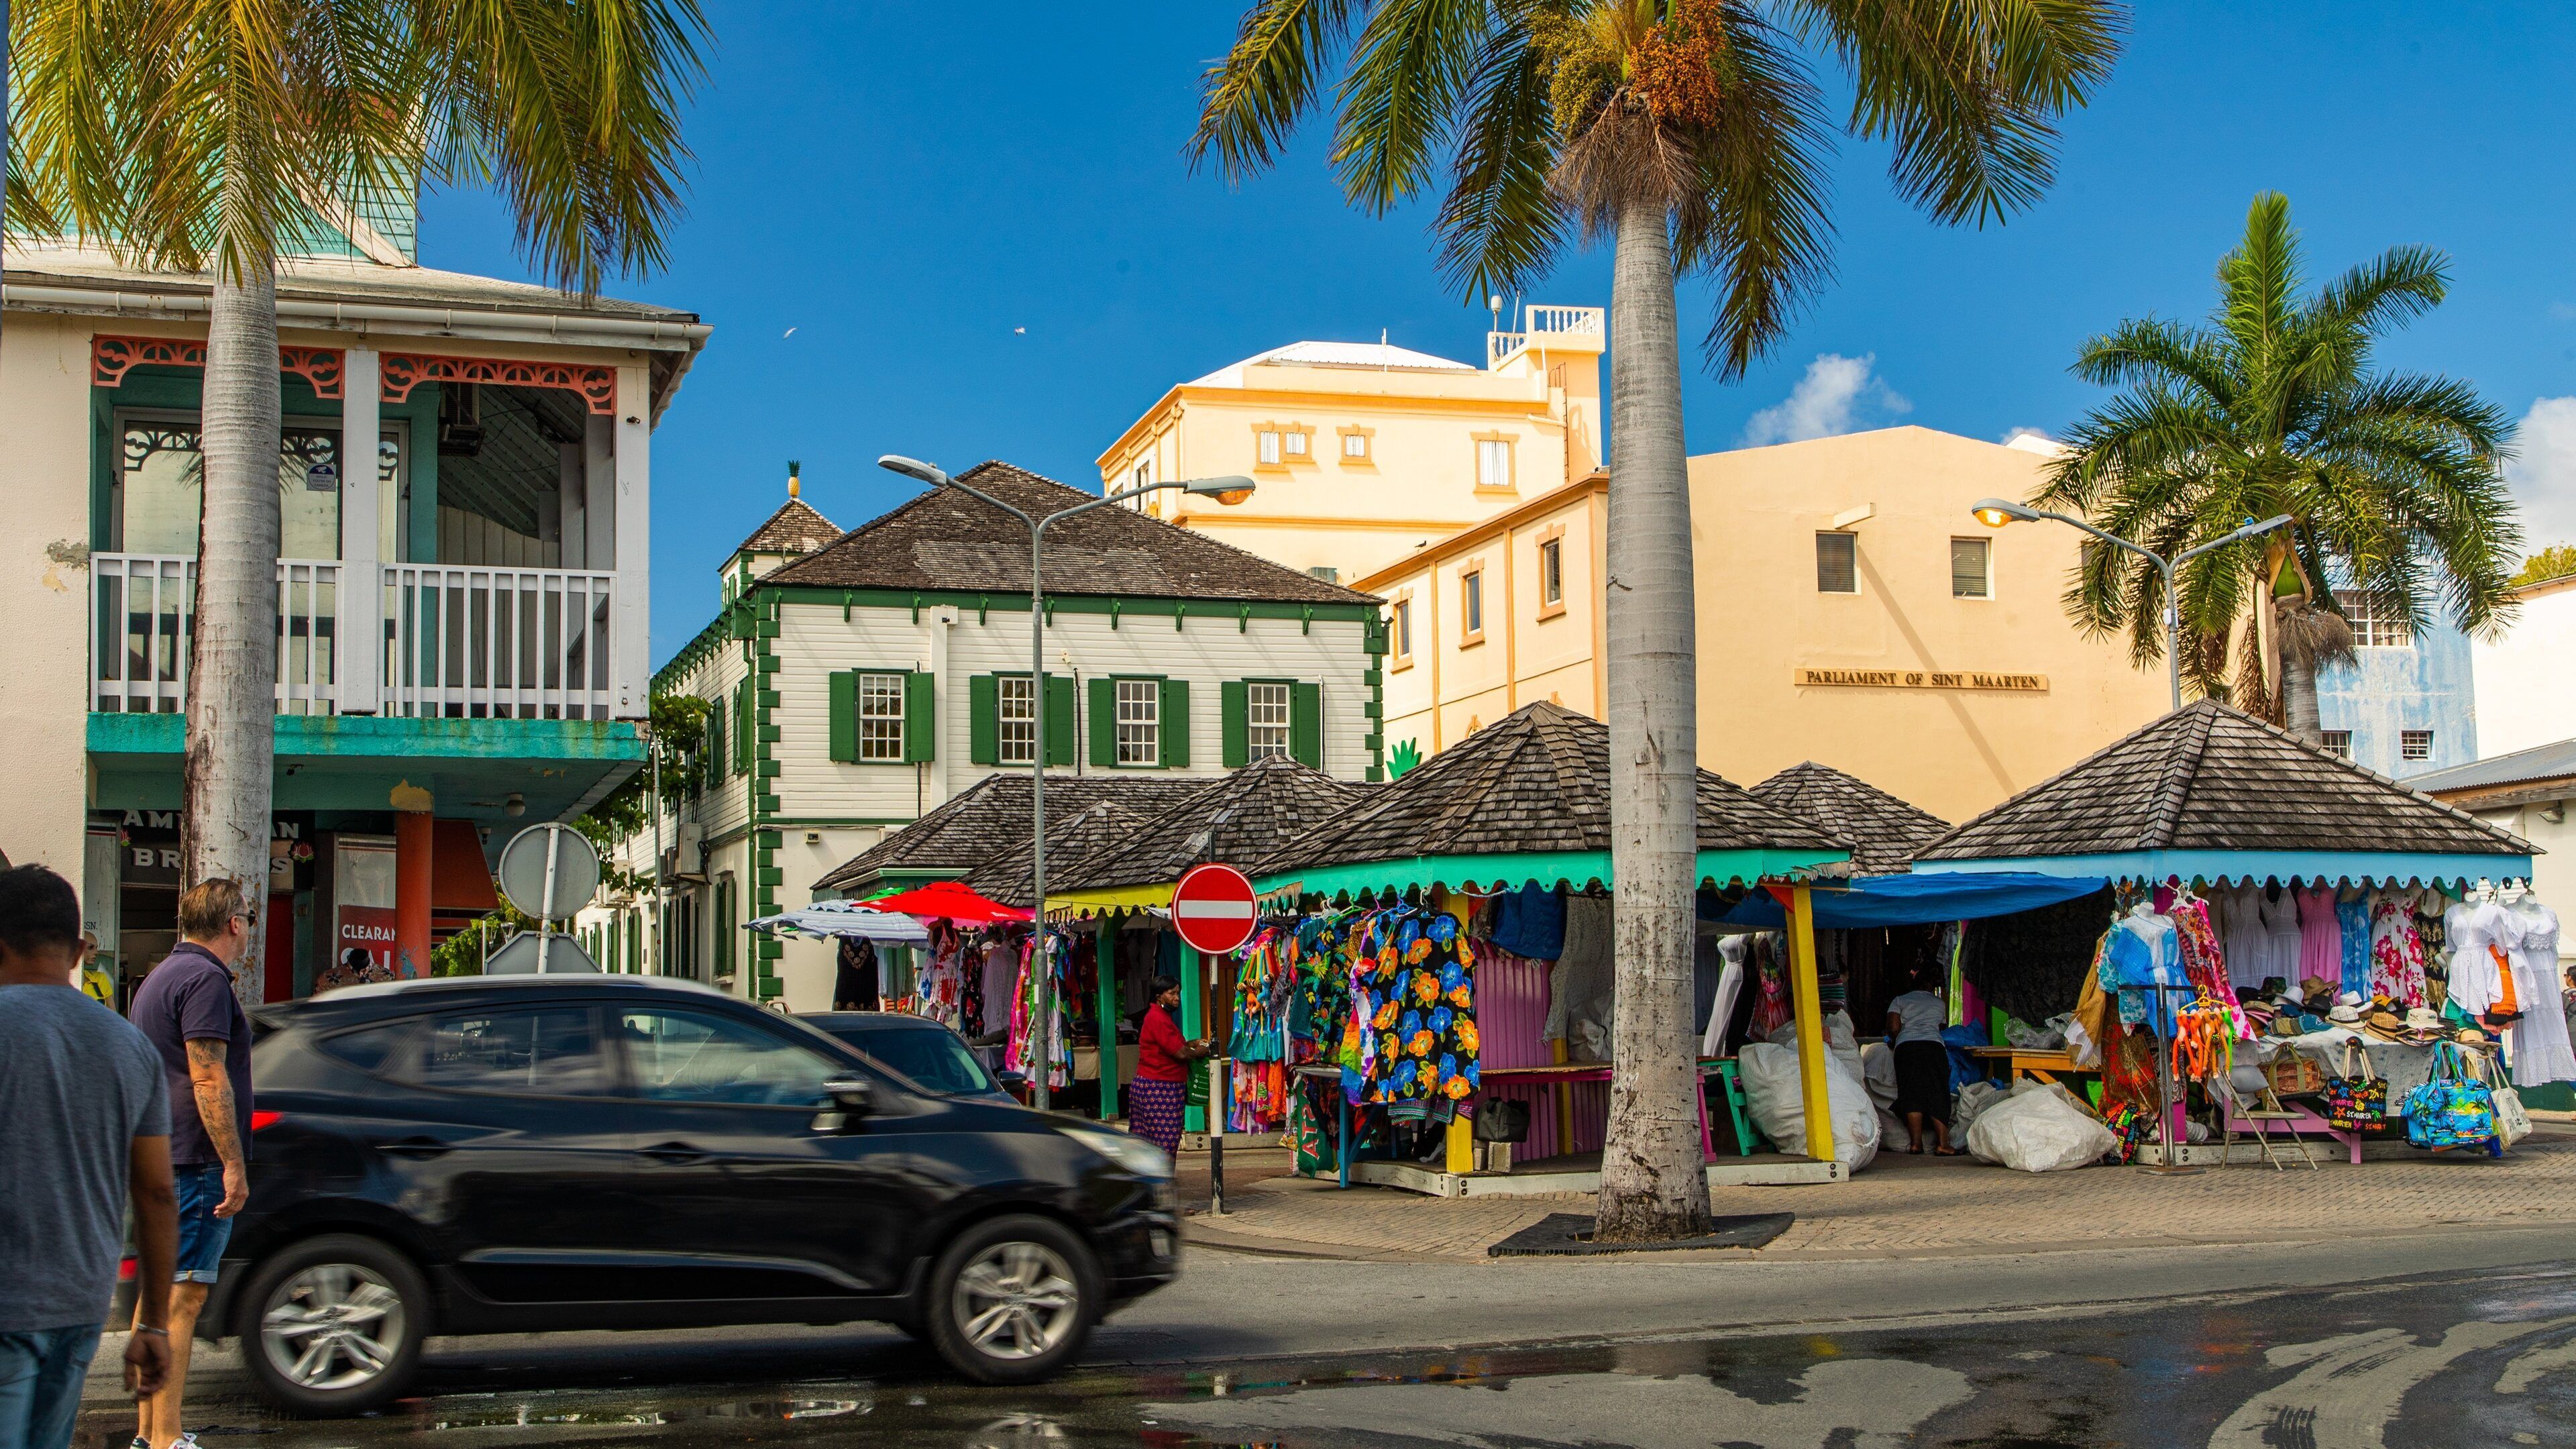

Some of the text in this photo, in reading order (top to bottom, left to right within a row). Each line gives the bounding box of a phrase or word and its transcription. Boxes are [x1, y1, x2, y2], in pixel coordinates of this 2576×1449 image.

[1806, 671, 2038, 687] PARLIAMENT OF SINT MAARTEN
